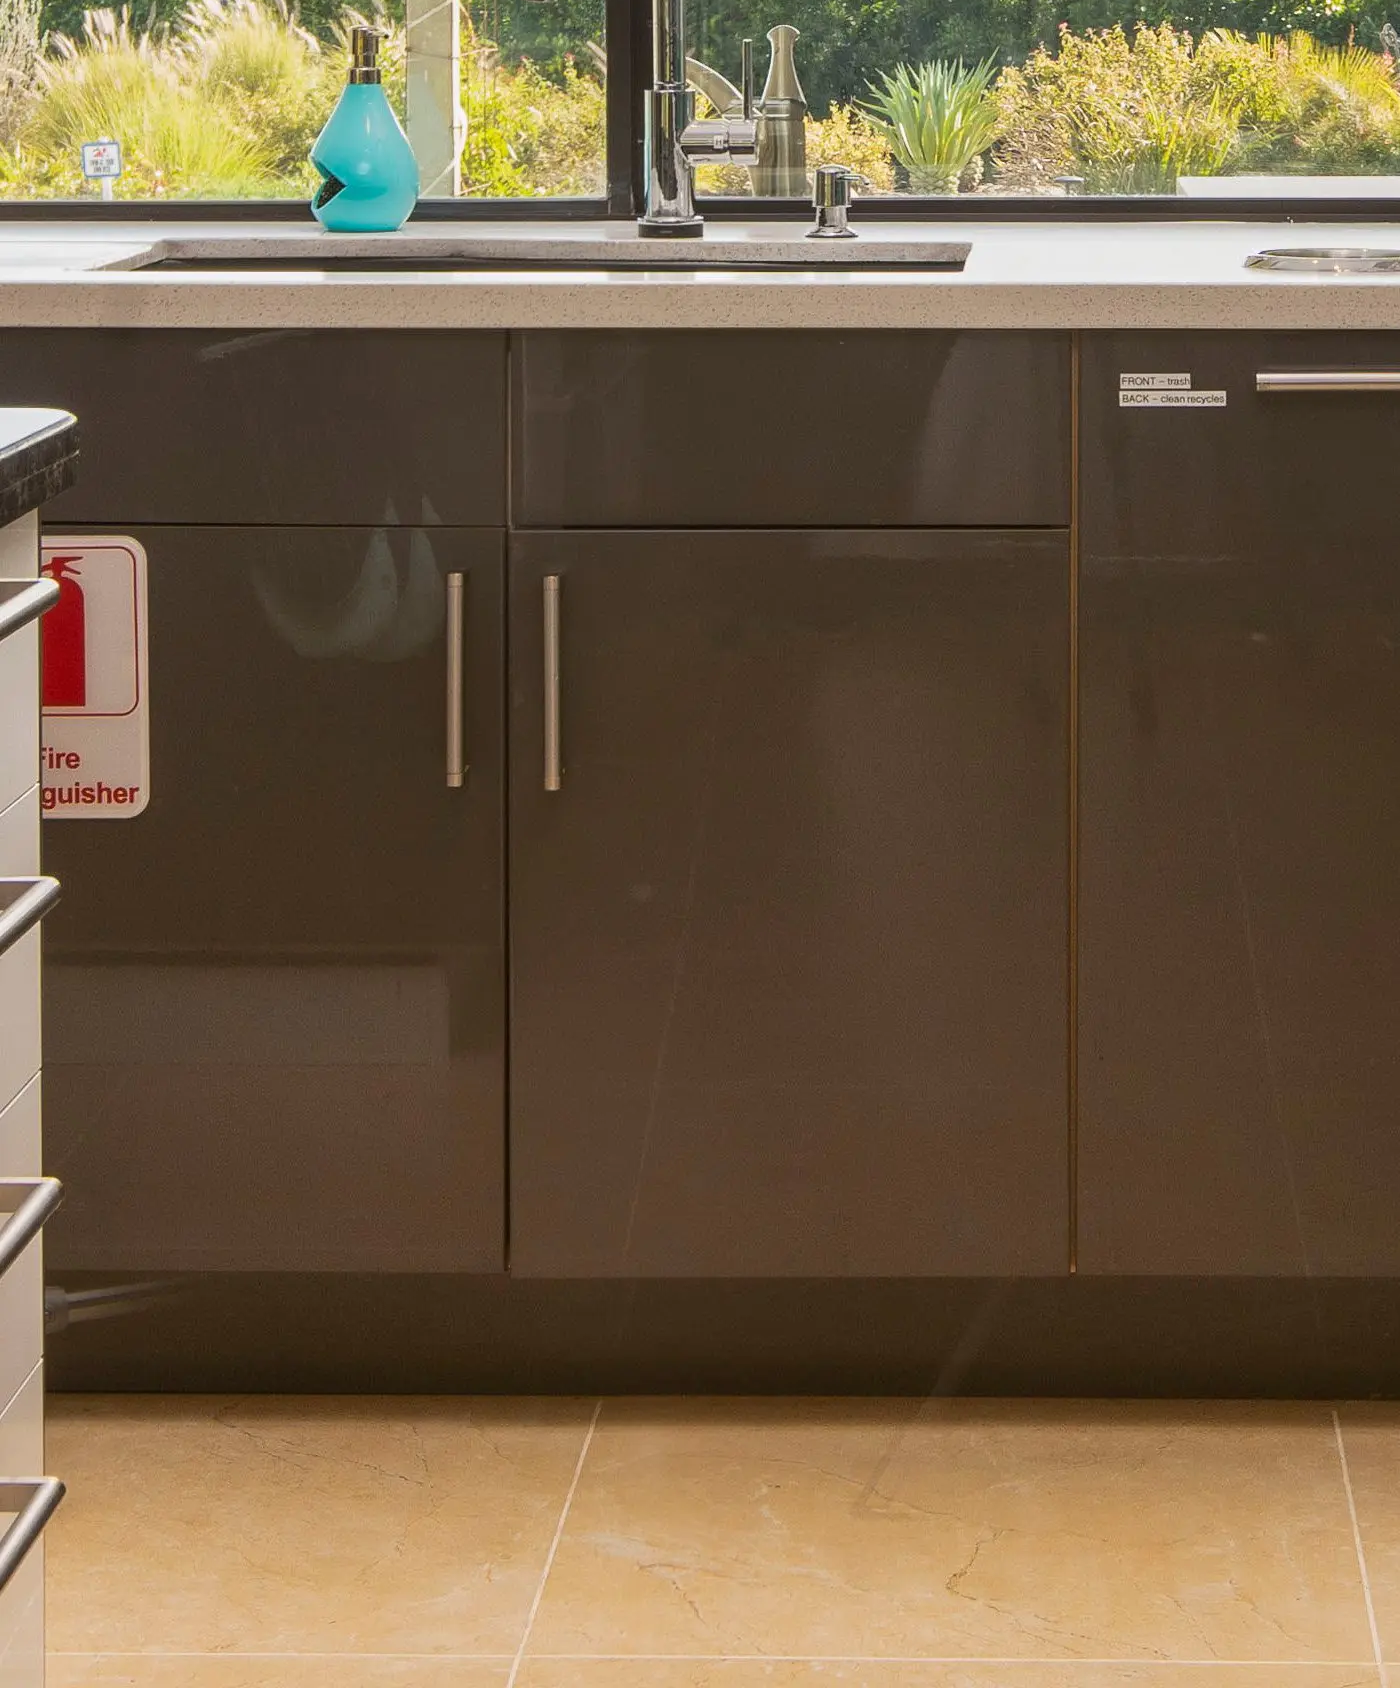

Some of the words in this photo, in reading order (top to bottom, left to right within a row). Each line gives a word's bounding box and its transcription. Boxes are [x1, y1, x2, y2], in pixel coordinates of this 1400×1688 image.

[1122, 376, 1156, 386] FRONT
[1167, 376, 1190, 386] trash
[1122, 394, 1149, 404] BACK
[1160, 394, 1186, 404] clean
[1187, 394, 1225, 405] recycles
